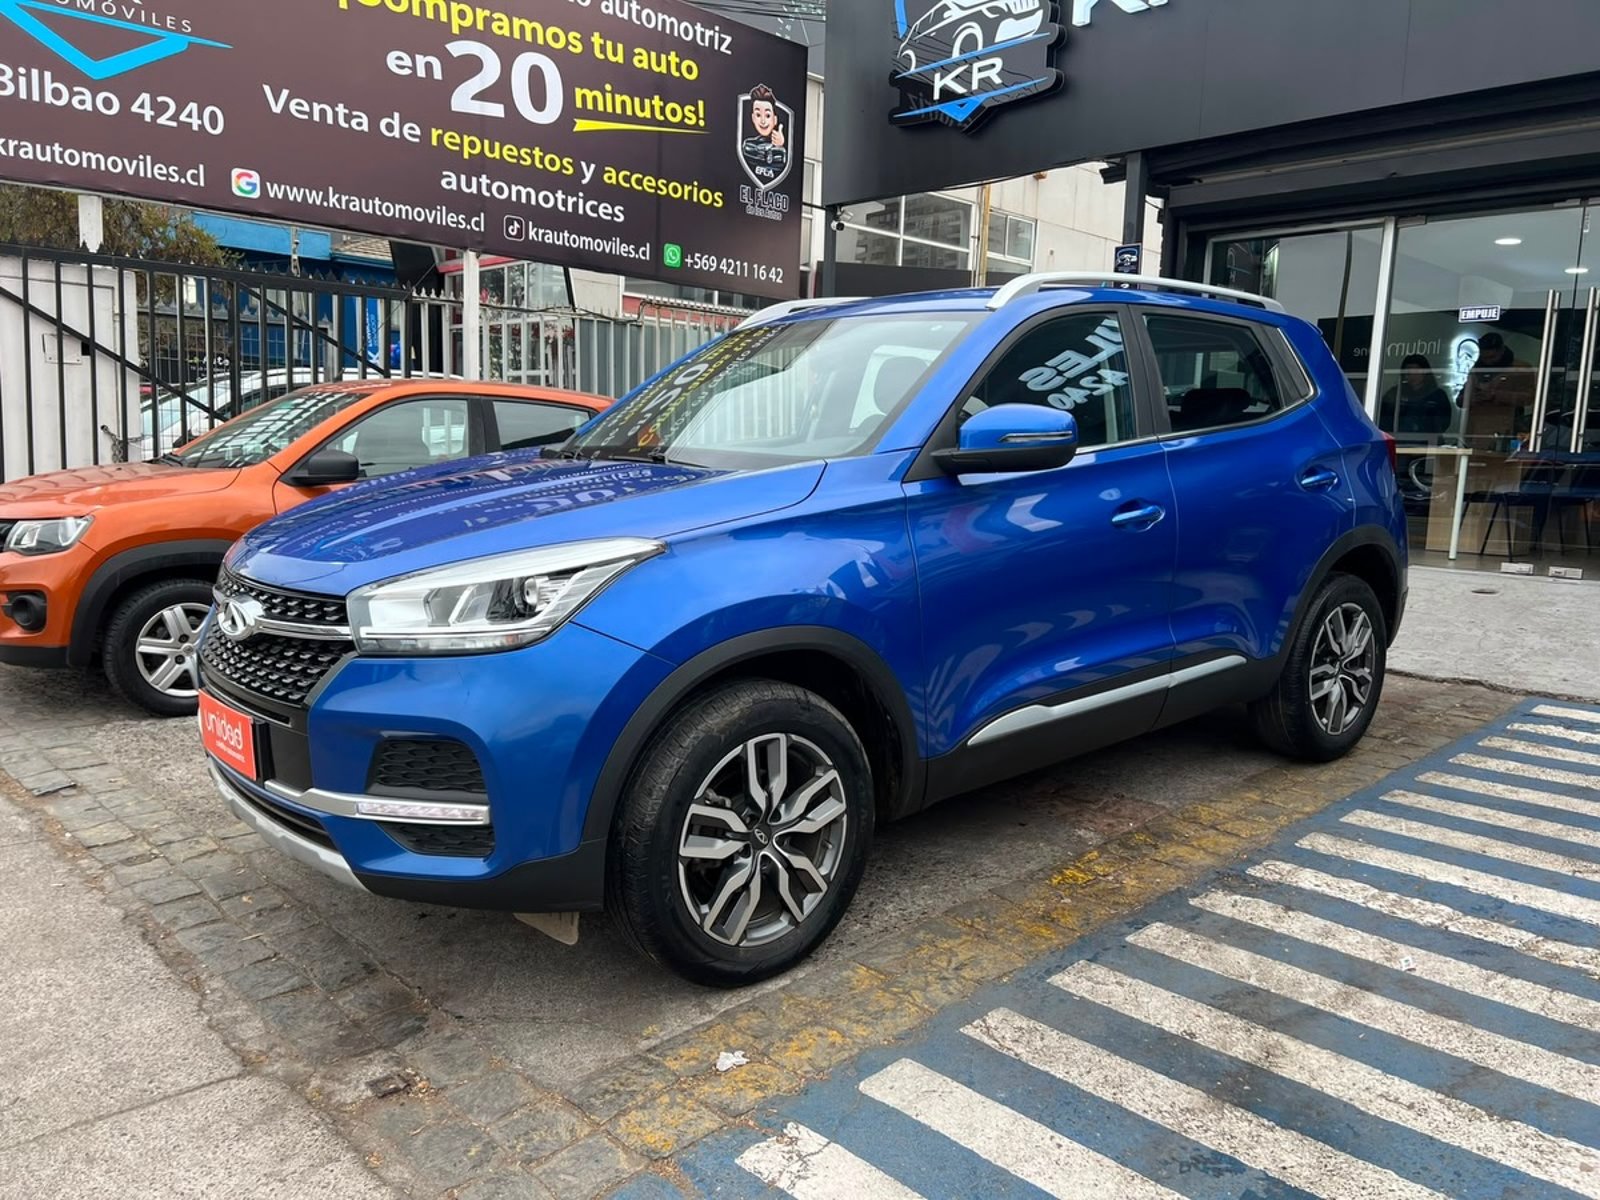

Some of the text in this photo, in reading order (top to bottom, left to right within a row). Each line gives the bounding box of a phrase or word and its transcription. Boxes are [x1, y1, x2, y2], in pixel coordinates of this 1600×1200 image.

[338, 0, 699, 81] ompramos tu auto
[600, 0, 733, 55] automotriz
[0, 63, 225, 135] Bilbao 4240
[386, 40, 705, 127] en 20 minutos!
[933, 57, 1004, 100] KR
[262, 84, 724, 208] Venta de repuestos y accesorios
[266, 182, 485, 232] www.krautomoviles.cl
[440, 170, 625, 222] automotrices
[528, 222, 650, 260] krautomoviles.cl
[684, 252, 783, 284] +569 4211 16 42
[1461, 308, 1498, 320] EMPUJE
[204, 709, 243, 750] unidad
